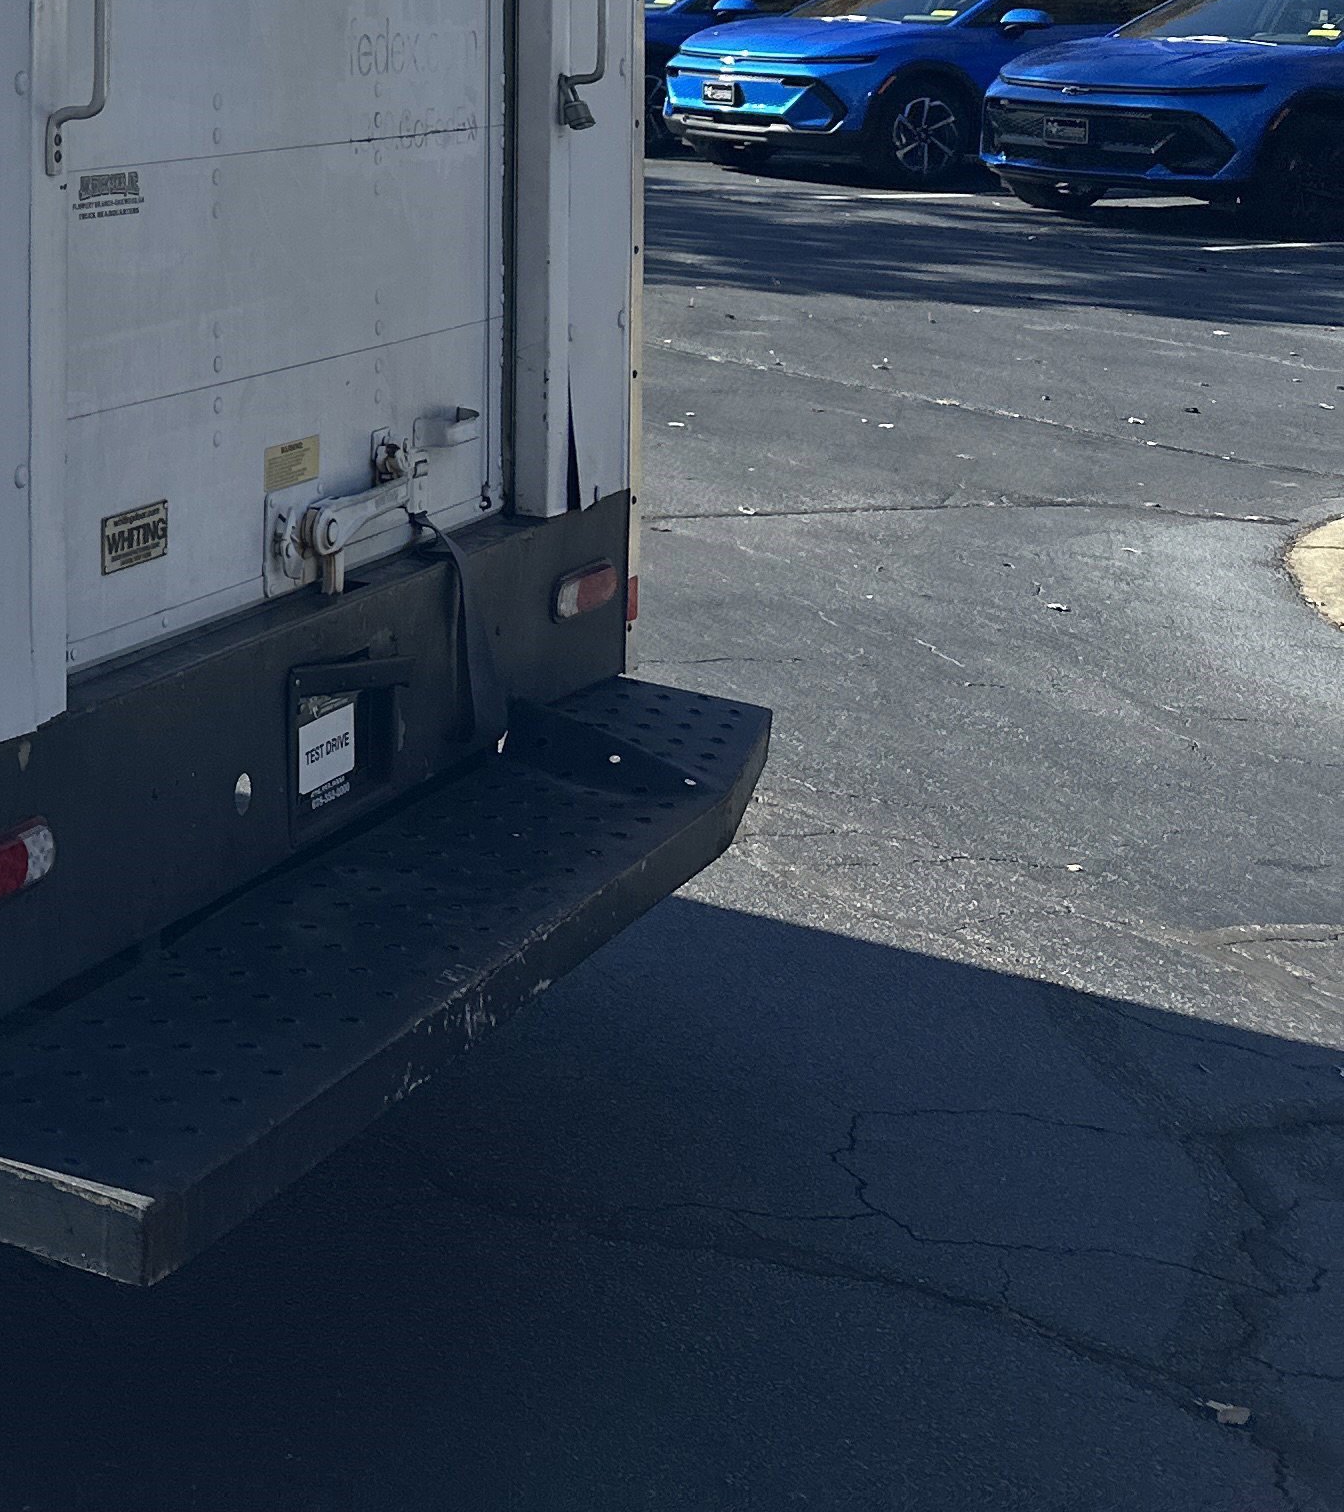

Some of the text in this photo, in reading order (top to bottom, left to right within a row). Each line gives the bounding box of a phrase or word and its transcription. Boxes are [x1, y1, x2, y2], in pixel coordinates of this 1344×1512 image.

[106, 517, 167, 555] WHITING
[304, 731, 350, 766] TEST DRIVE
